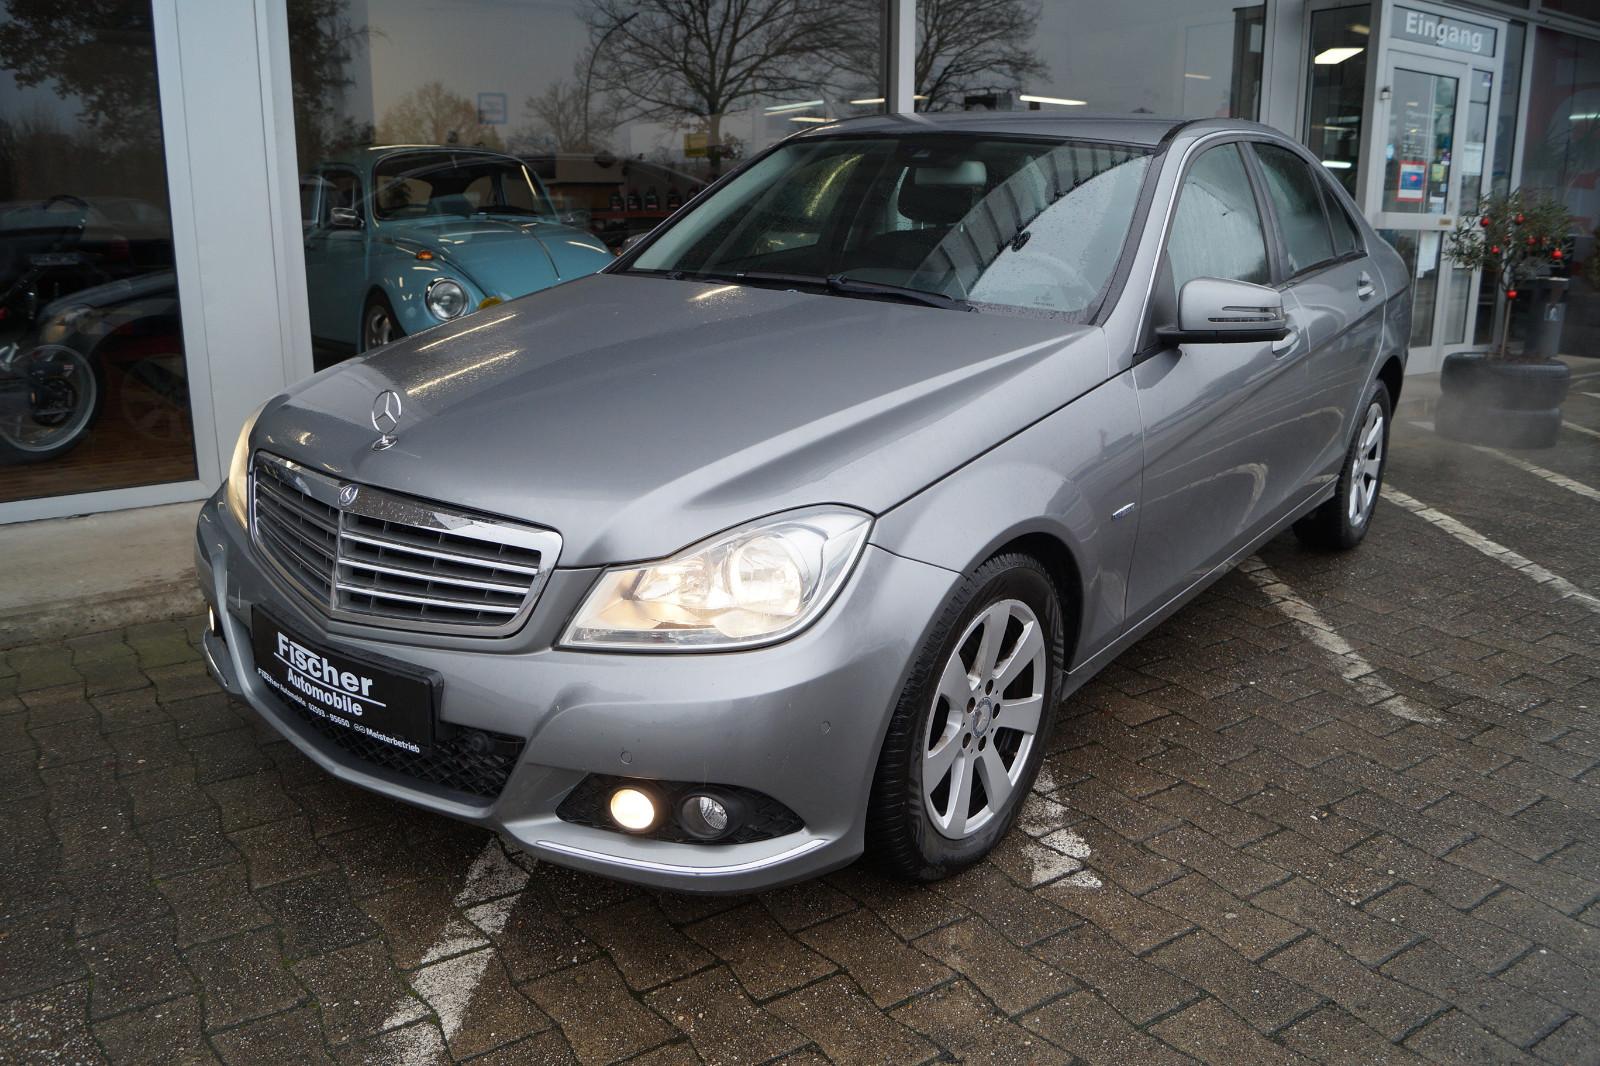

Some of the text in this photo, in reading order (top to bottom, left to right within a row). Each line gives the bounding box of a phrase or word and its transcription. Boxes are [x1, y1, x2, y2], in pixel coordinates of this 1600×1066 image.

[1405, 12, 1483, 53] Eingang
[278, 632, 373, 697] Fischer
[287, 667, 363, 717] Automobile
[366, 728, 420, 753] Meisterbetrieb
